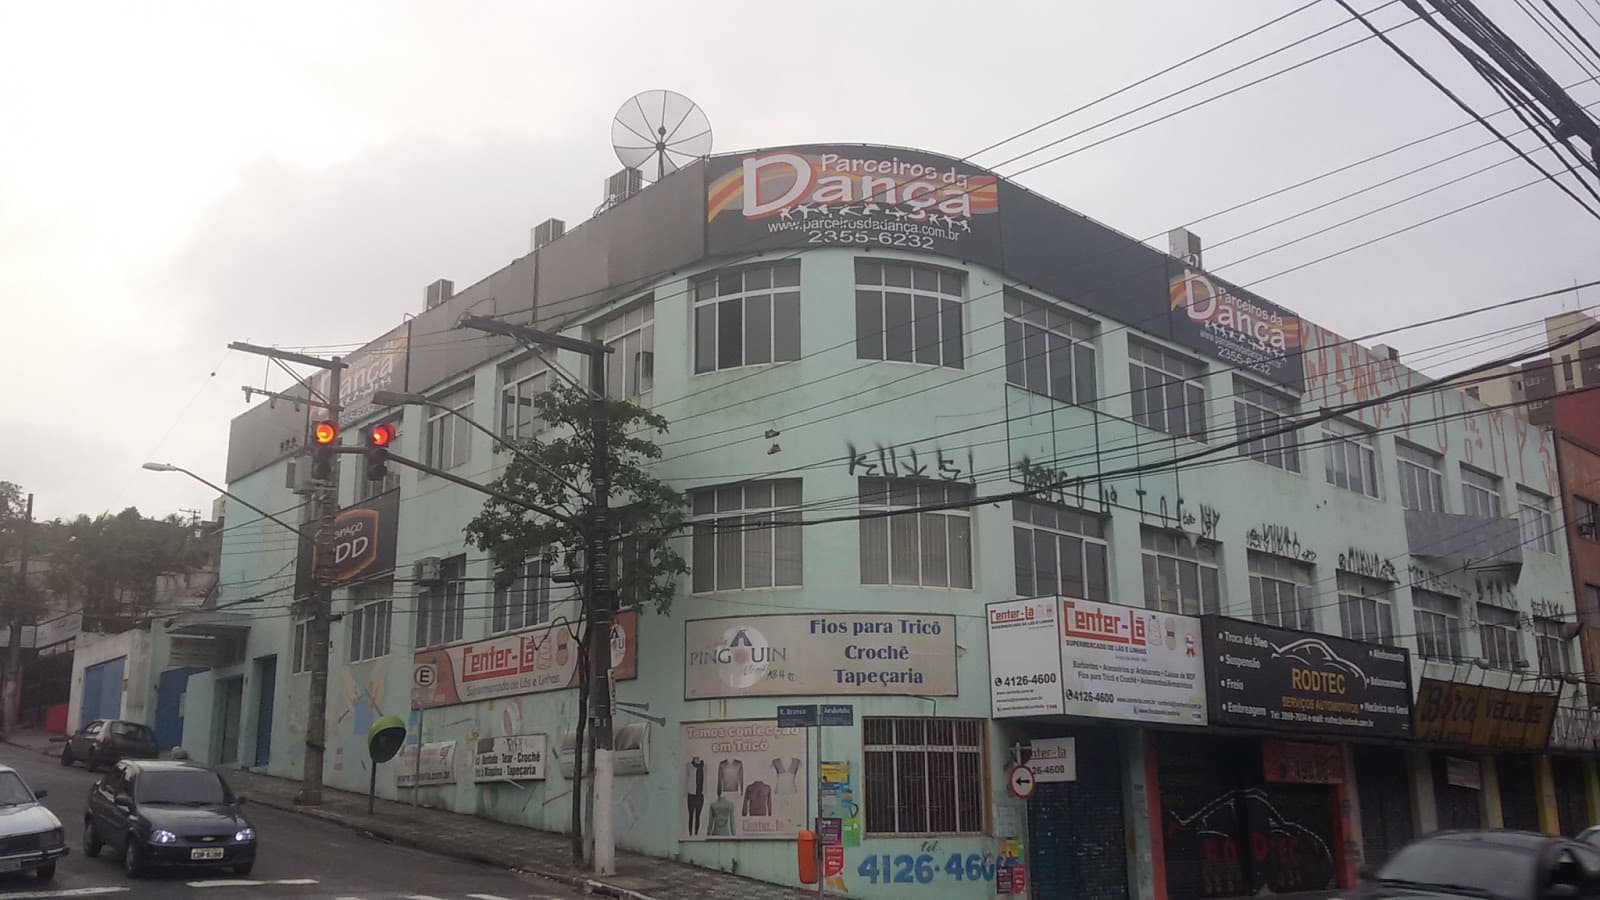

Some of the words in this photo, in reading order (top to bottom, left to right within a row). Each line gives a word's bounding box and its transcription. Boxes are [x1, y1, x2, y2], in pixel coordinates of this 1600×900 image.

[821, 153, 937, 180] Parceiros
[943, 168, 968, 188] da
[742, 153, 972, 219] Dança
[768, 218, 960, 241] www.parceirosdadança.com.br
[808, 230, 935, 250] 2355-6232
[1184, 269, 1286, 351] Dança
[1217, 286, 1269, 321] Parceiros
[1271, 311, 1283, 326] da
[810, 619, 848, 635] Fios
[853, 620, 893, 639] para
[898, 619, 942, 635] Tricô
[1063, 600, 1147, 646] Center-Lã
[1224, 632, 1243, 646] Troca
[1244, 635, 1252, 646] de
[844, 645, 909, 660] Crochê
[1226, 655, 1261, 669] Suspensão
[419, 669, 430, 684] E
[833, 669, 923, 686] Tapeçaria
[1004, 673, 1057, 687] 4126-4600
[1291, 667, 1346, 695] RODTEC
[1226, 679, 1244, 691] Freio
[1073, 690, 1114, 703] 4126-4600
[1228, 702, 1267, 718] Embreagem
[687, 726, 724, 739] Temos
[712, 742, 731, 752] em
[517, 751, 541, 764] Crochê
[1031, 764, 1065, 775] 26-4600
